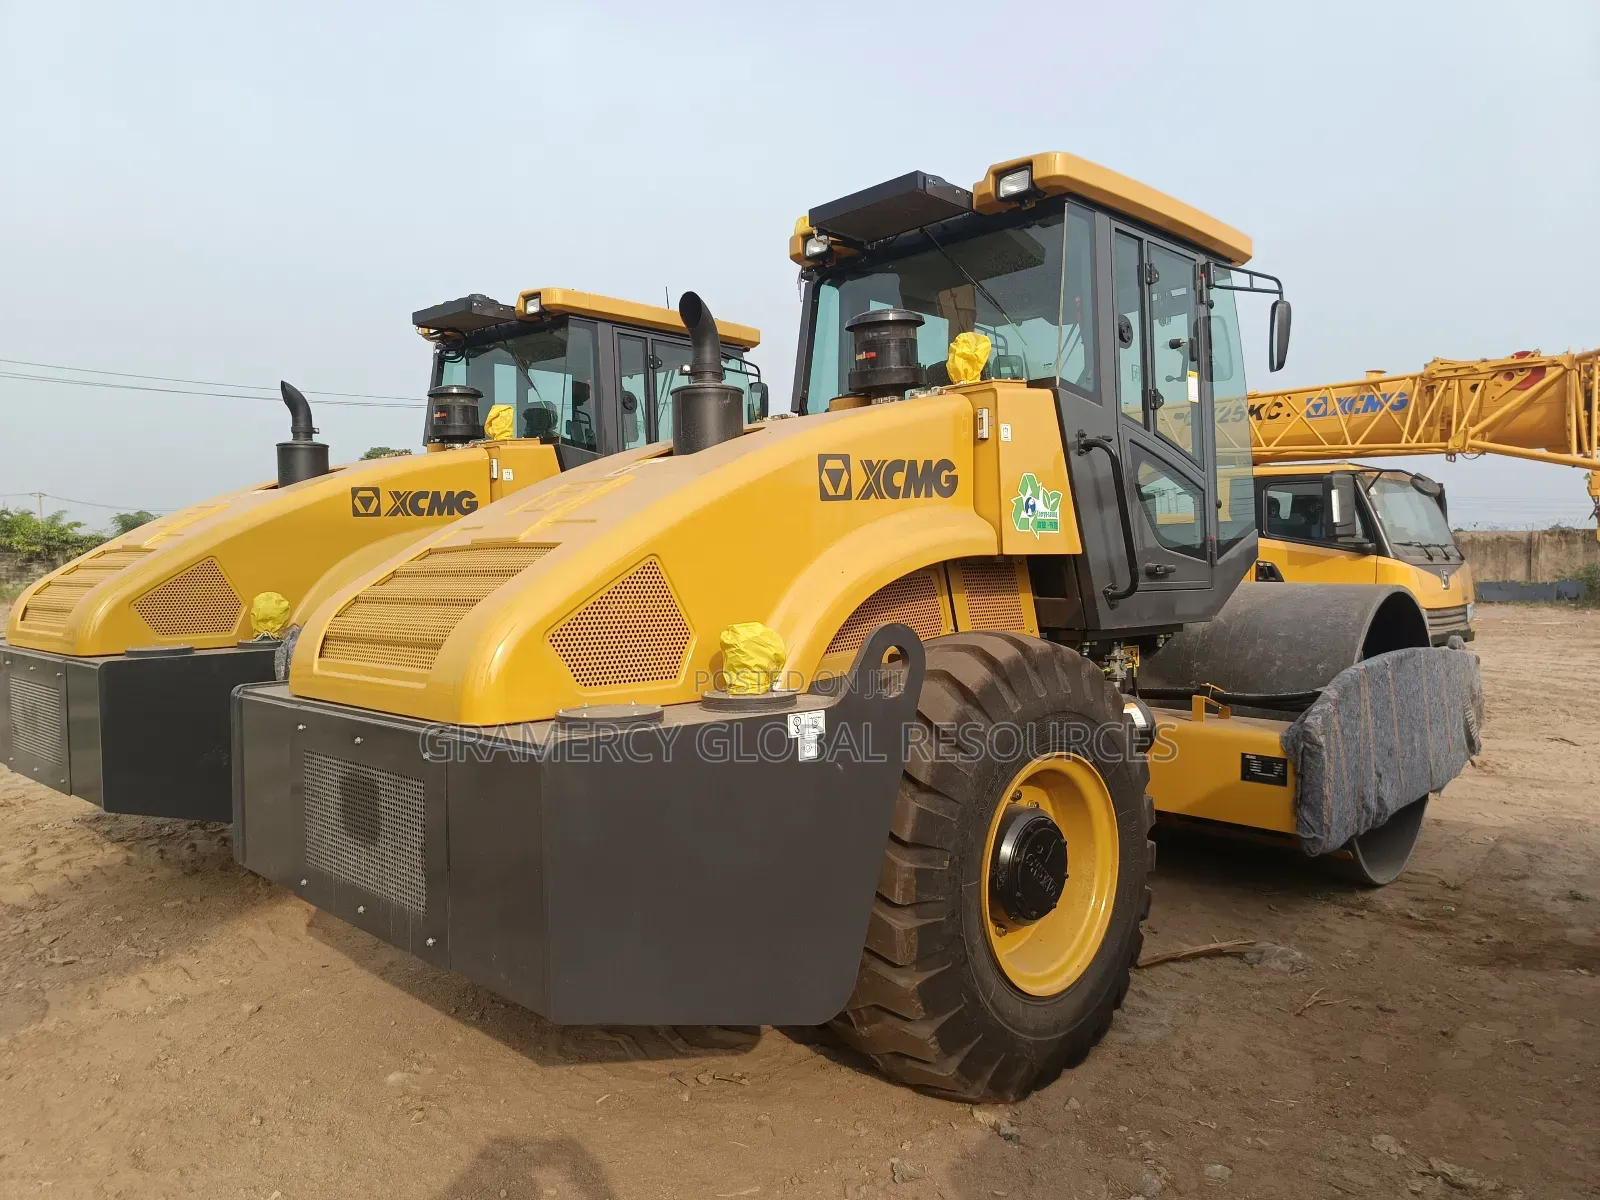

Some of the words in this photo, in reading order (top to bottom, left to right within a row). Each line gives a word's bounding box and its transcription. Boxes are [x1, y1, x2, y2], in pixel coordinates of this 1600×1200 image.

[1329, 391, 1409, 417] XCMG
[855, 458, 958, 500] XCMG
[384, 489, 478, 517] XCMG
